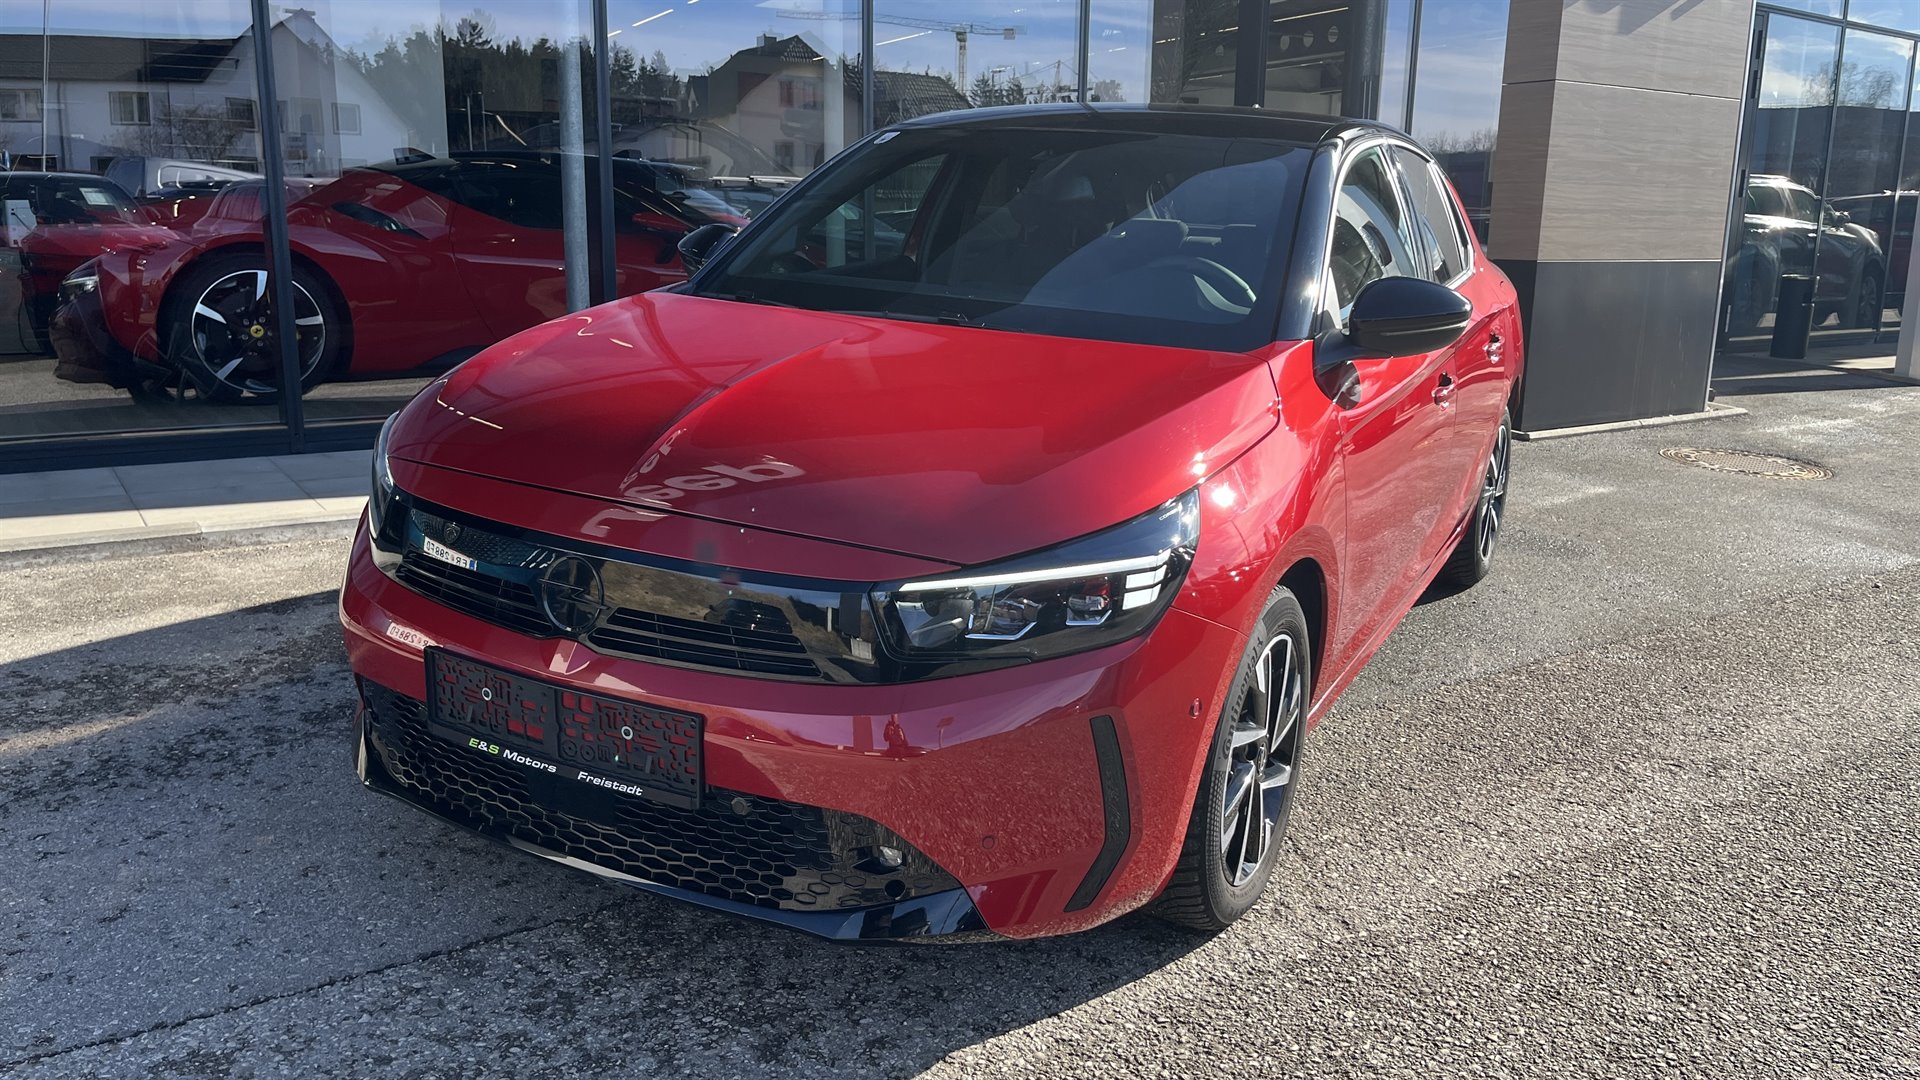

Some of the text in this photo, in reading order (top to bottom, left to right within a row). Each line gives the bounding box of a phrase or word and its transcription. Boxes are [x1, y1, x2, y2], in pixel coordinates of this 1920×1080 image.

[469, 738, 643, 796] E&S Motors Freistadt
